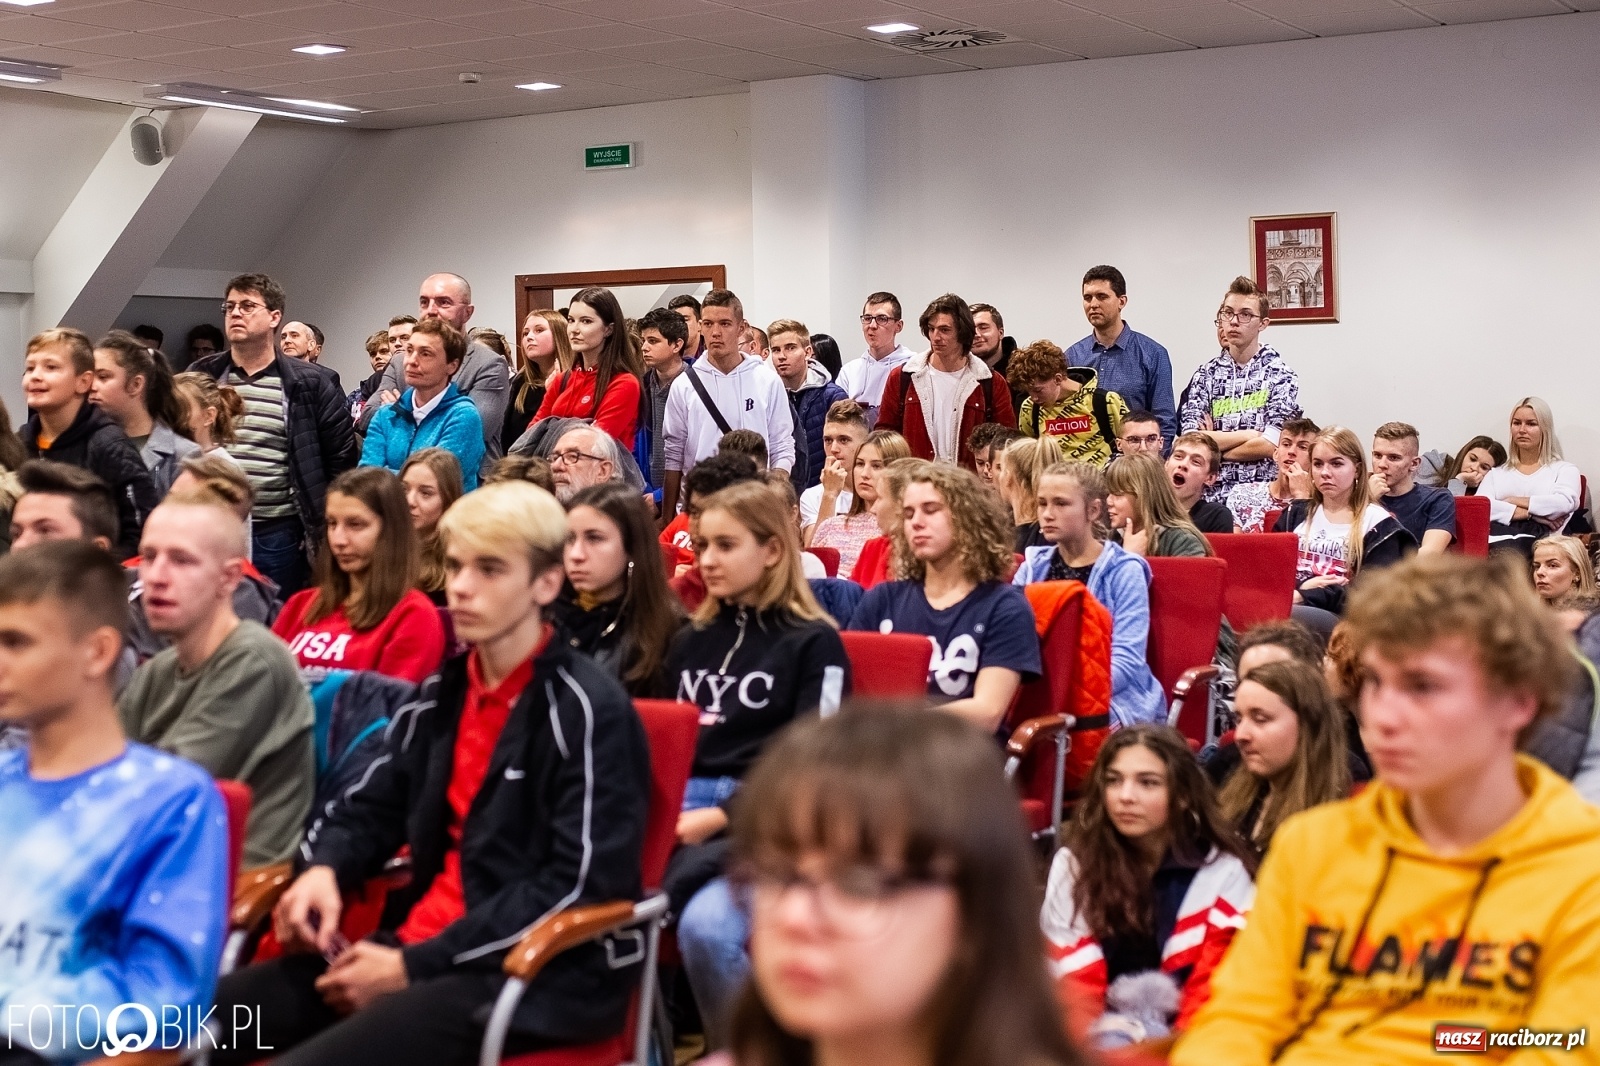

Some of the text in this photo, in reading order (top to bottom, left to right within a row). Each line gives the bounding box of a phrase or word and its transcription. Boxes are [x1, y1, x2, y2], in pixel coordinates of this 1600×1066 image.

[593, 149, 622, 158] WYJŚCIE
[745, 398, 754, 411] B
[1048, 420, 1089, 432] ACTION
[288, 631, 352, 662] USA
[676, 668, 775, 713] NYC
[1298, 924, 1542, 994] FLAMES
